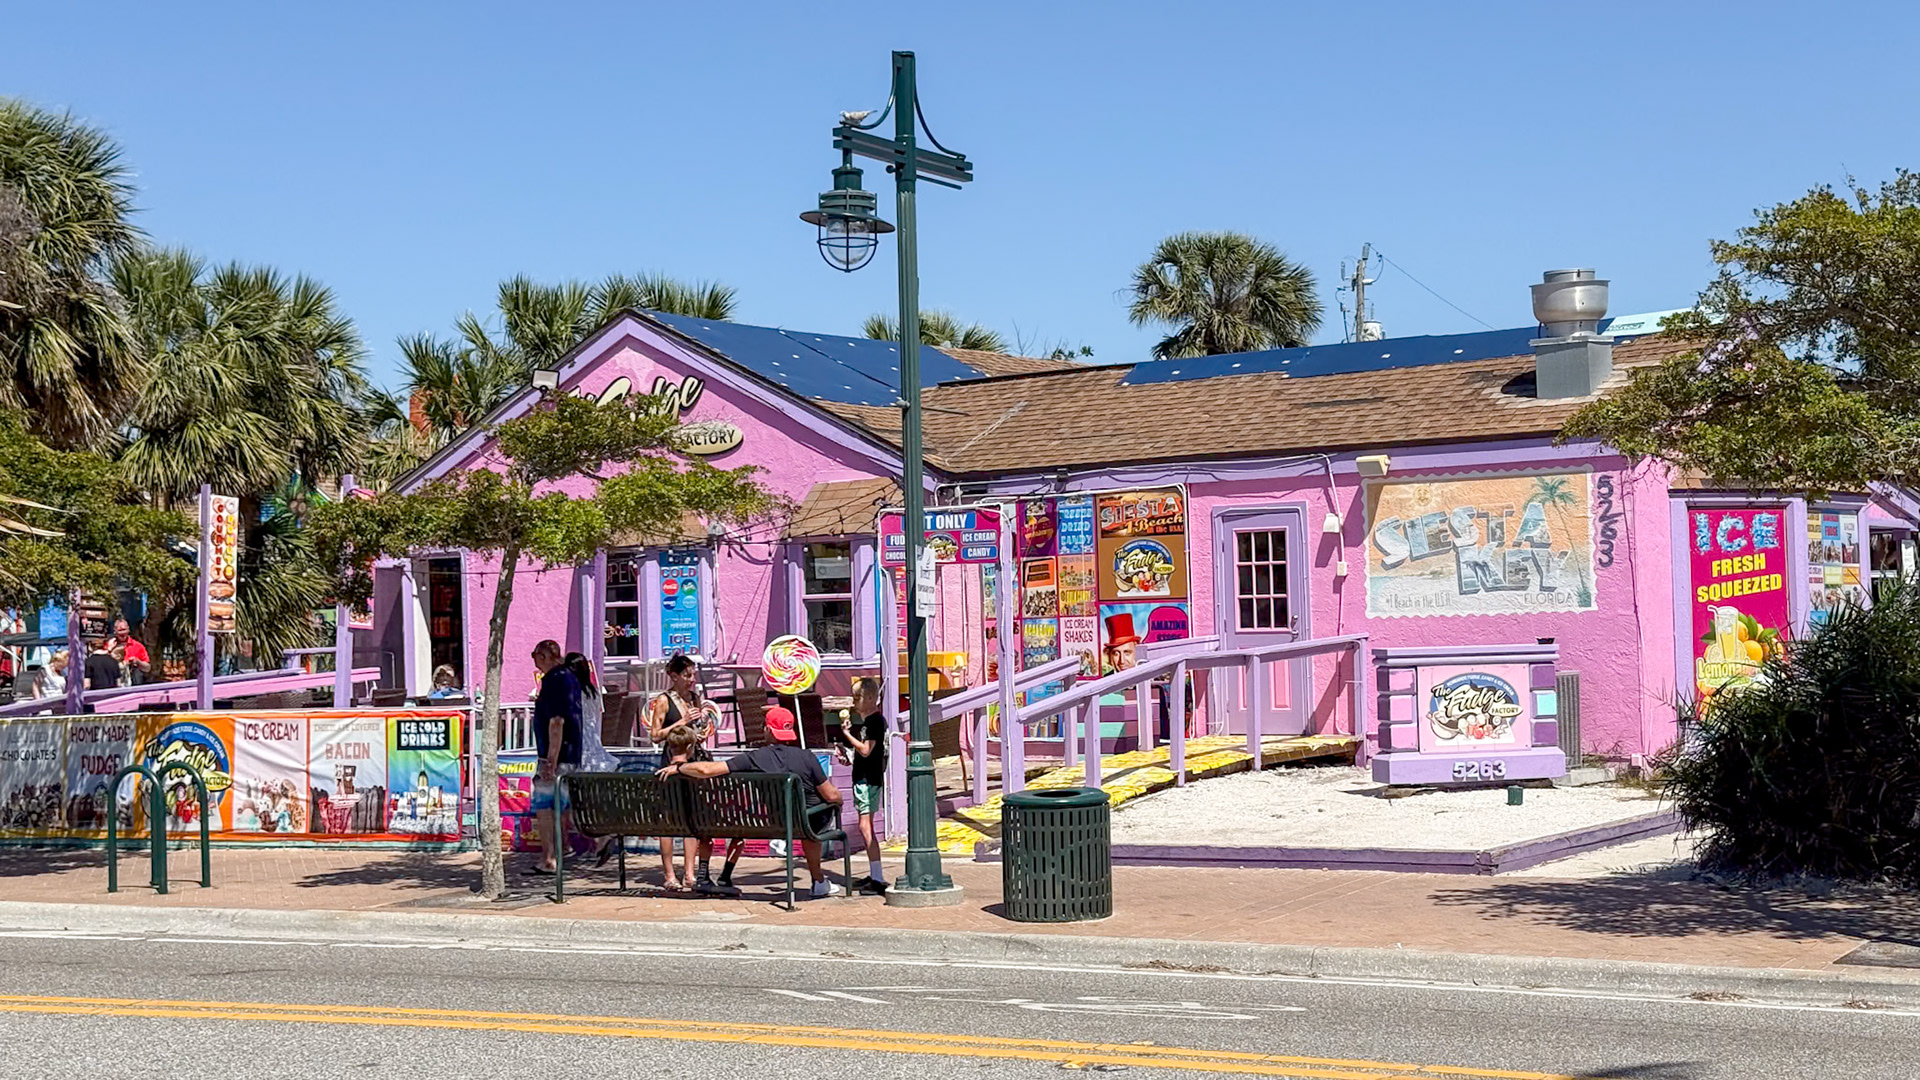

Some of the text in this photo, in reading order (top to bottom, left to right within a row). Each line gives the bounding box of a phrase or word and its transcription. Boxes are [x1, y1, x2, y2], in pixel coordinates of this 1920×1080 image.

[682, 430, 736, 447] ACTORY
[1100, 497, 1182, 529] SIESTA
[1597, 475, 1625, 568] 5263
[936, 514, 967, 530] ONLY
[1061, 521, 1091, 532] DRIED
[1134, 514, 1183, 533] Beach
[890, 535, 906, 546] FUD
[962, 531, 996, 542] ICE CREAM
[1373, 502, 1551, 570] SIESTA
[1695, 513, 1779, 553] ICE
[967, 547, 991, 558] CANDY
[1124, 549, 1164, 576] Fudge
[1712, 552, 1766, 577] FRESH
[661, 566, 697, 578] COLD
[1456, 549, 1571, 596] KEY
[1697, 573, 1782, 603] SQUEEZED
[1524, 591, 1574, 605] FLORIDA
[614, 623, 640, 637] Coffee
[1064, 619, 1093, 629] ICE CREAM
[669, 633, 692, 644] ICE
[1064, 631, 1094, 642] SHAKES
[663, 645, 699, 656] COLD
[1434, 685, 1451, 698] The
[1445, 684, 1505, 717] Fudge
[243, 722, 299, 740] ICE CREAM
[401, 722, 445, 733] ICE COLD
[146, 740, 164, 757] The
[401, 734, 445, 747] DRINKS
[326, 742, 370, 759] BACON
[80, 755, 120, 775] FUDGE
[1453, 760, 1507, 782] 5263
